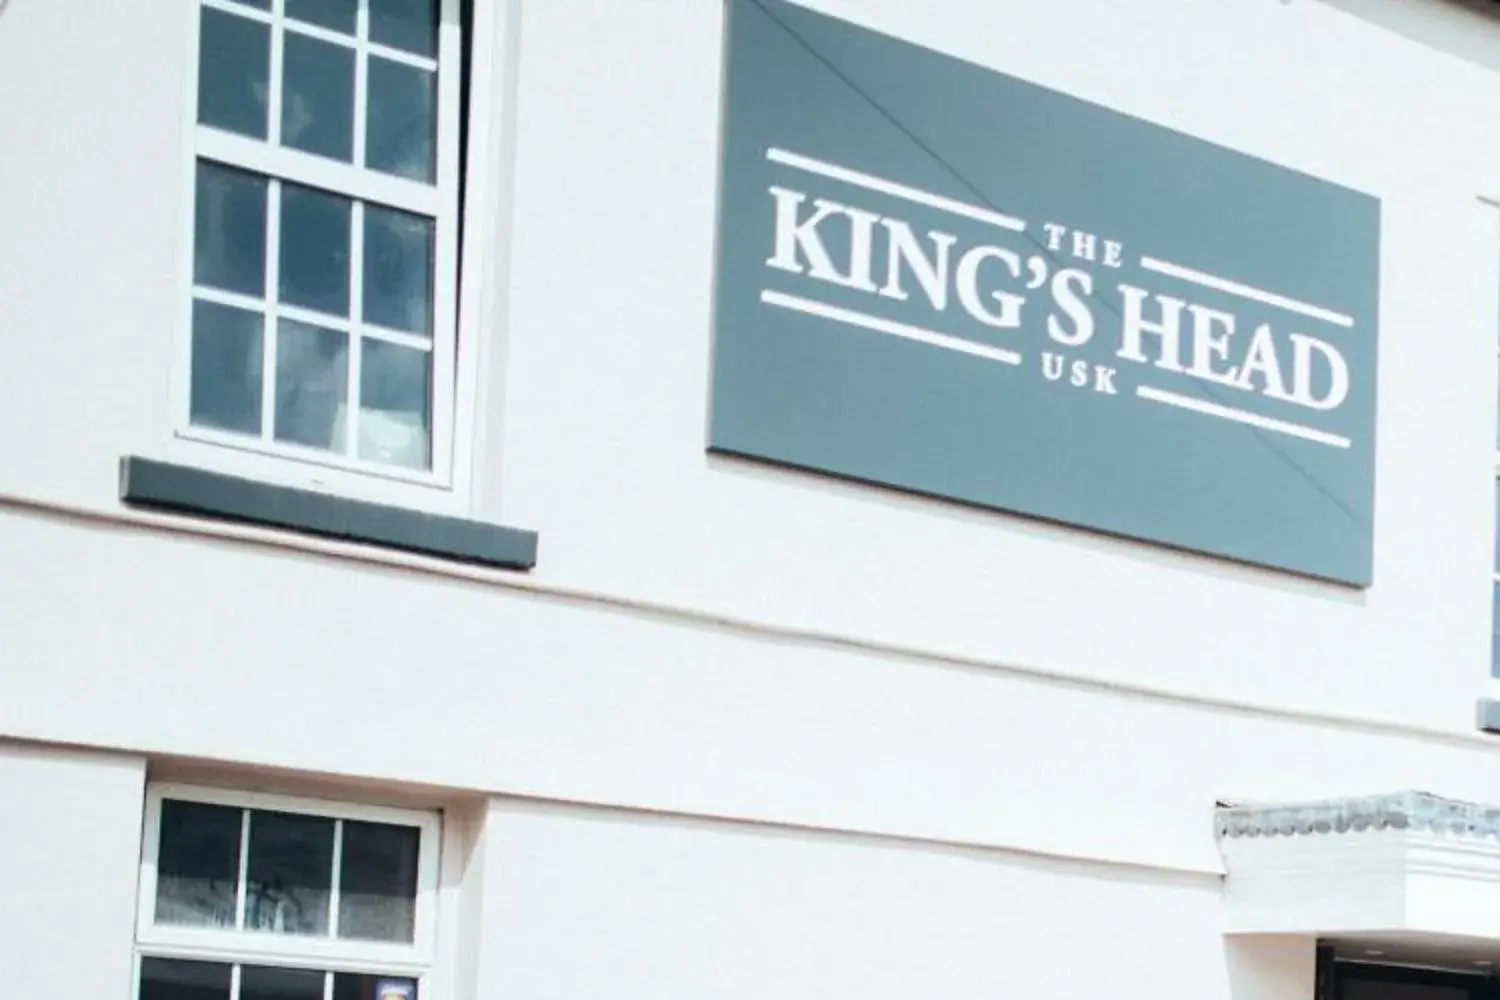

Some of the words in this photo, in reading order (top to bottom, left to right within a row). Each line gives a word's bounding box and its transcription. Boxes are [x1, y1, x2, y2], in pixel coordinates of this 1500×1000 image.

[1043, 223, 1122, 268] THE
[765, 186, 1094, 346] KING'S
[1115, 283, 1350, 411] HEAD
[1041, 352, 1117, 395] USK
